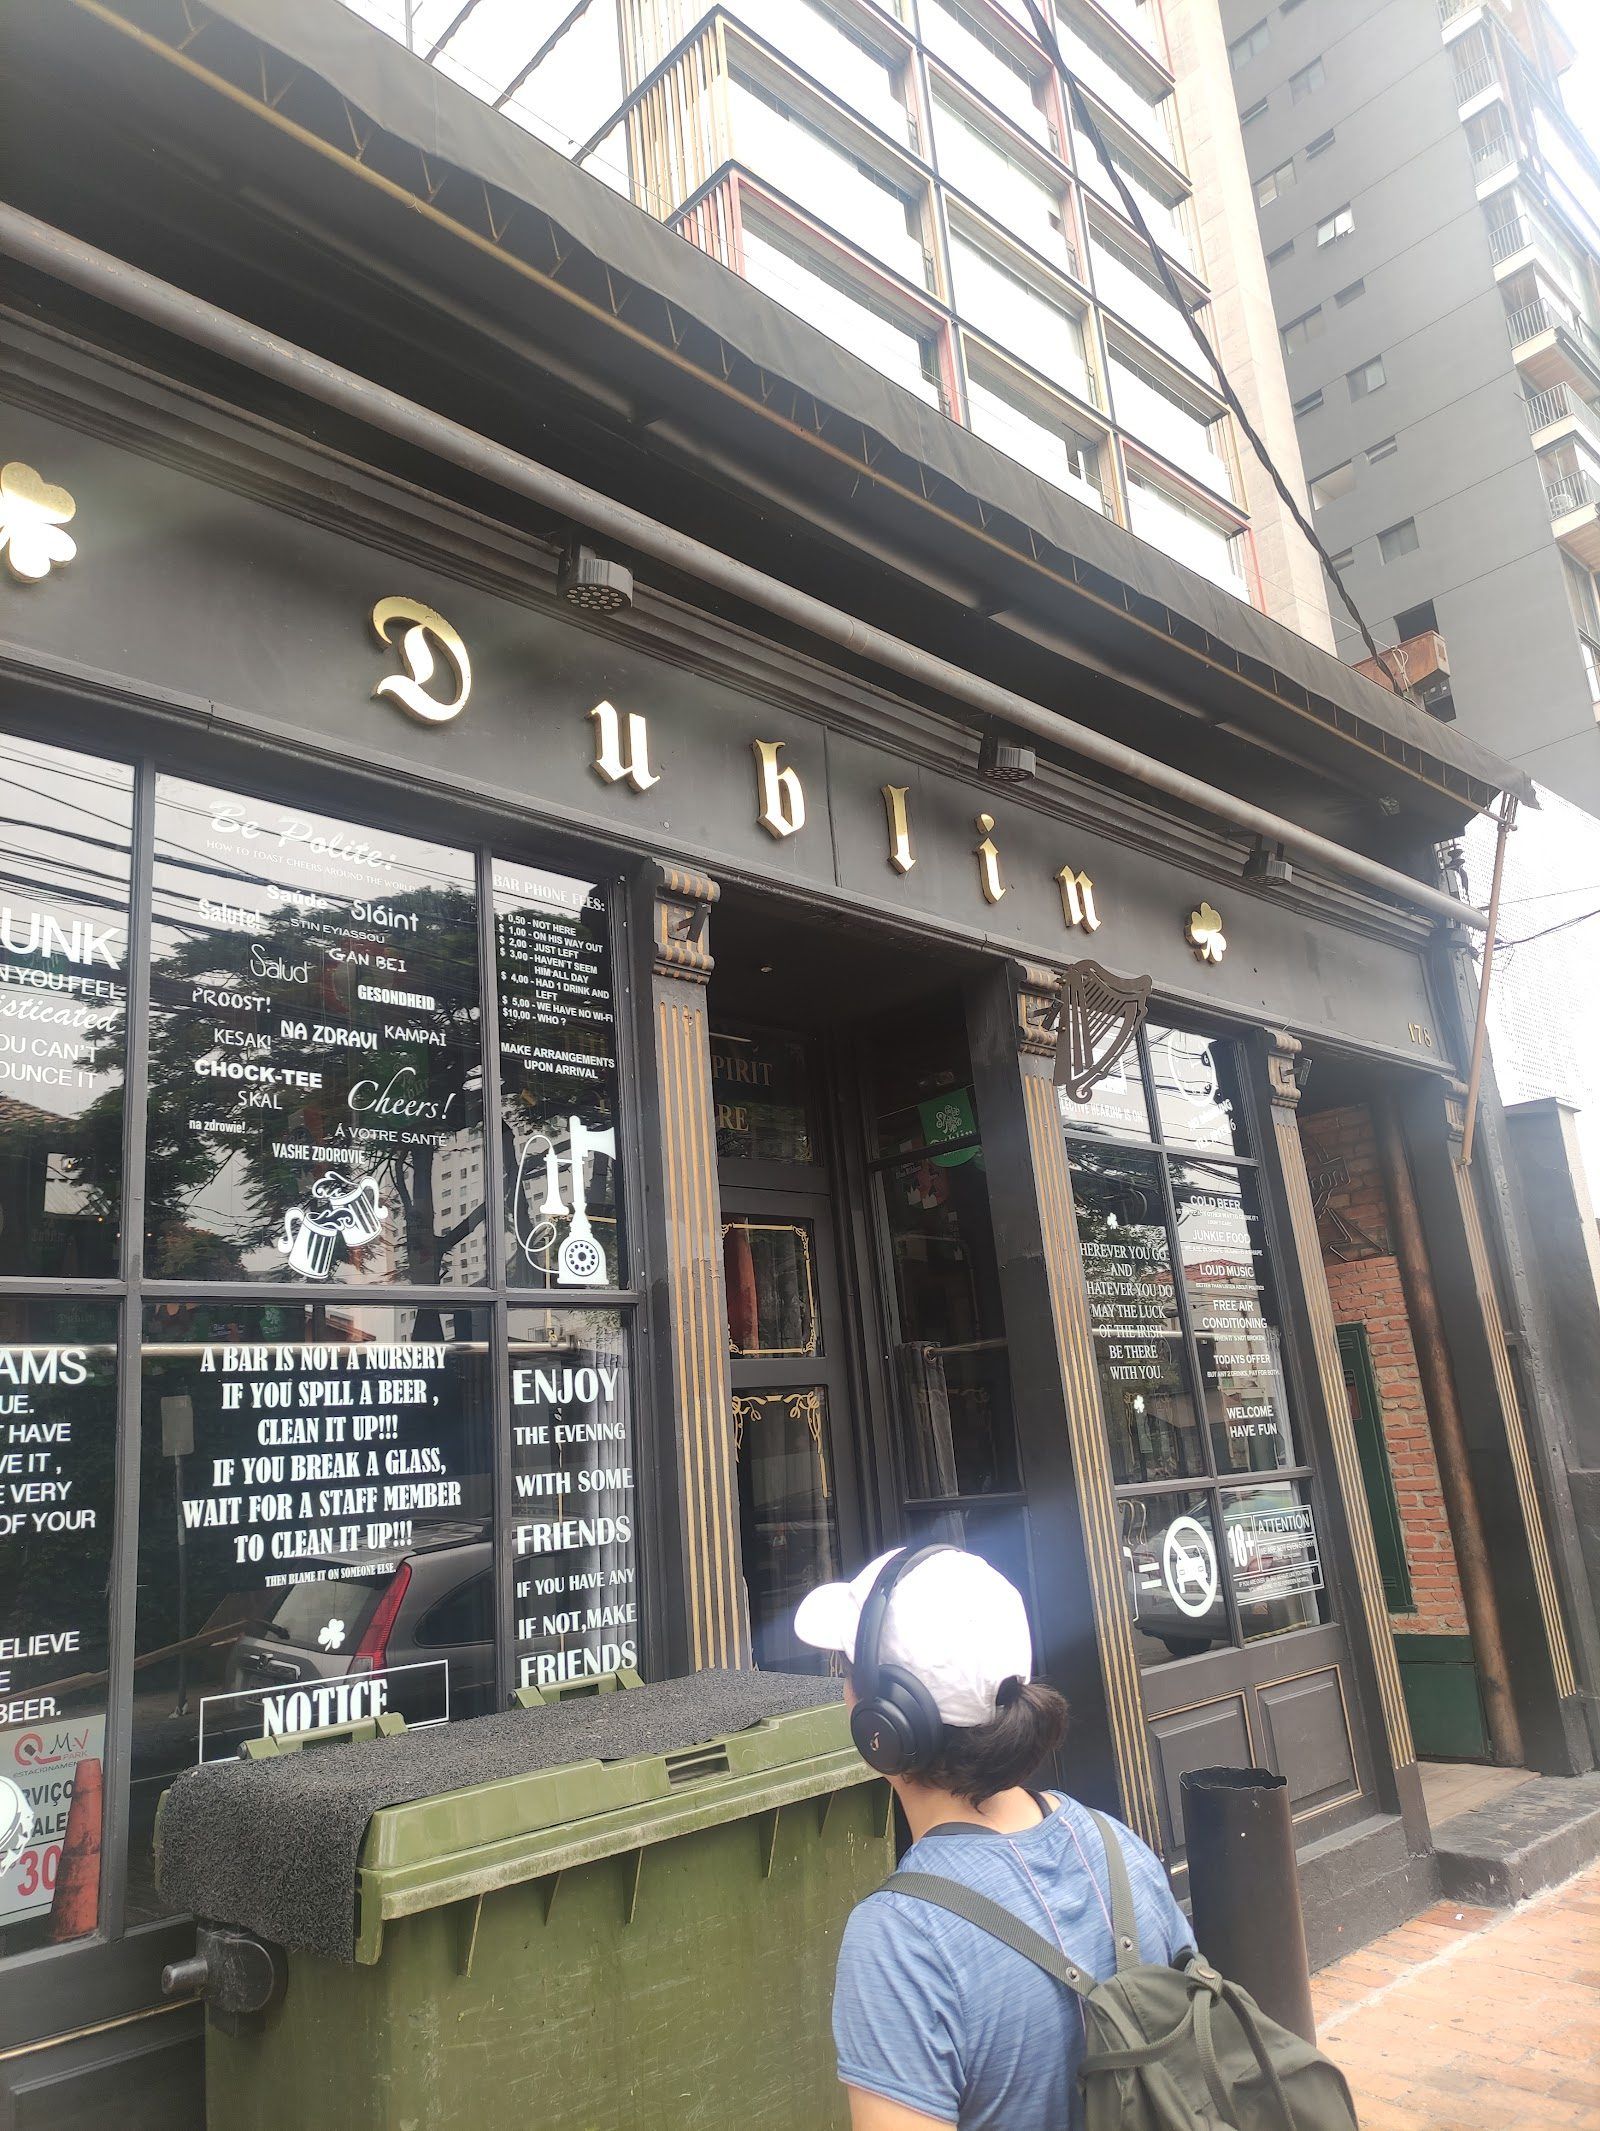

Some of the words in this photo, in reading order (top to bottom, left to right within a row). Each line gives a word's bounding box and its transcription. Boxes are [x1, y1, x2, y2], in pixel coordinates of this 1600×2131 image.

[370, 595, 1102, 936] Dublin
[209, 801, 262, 840] Be
[278, 816, 397, 870] Polite:
[206, 840, 233, 854] HOW
[253, 849, 284, 865] TOAST
[286, 858, 324, 874] CHEERS
[324, 867, 364, 882] AROUND
[365, 875, 385, 887] THE
[266, 883, 330, 911] Saúde
[493, 874, 520, 892] BAR
[524, 881, 568, 904] PHONE
[572, 891, 606, 912] FEES:
[350, 898, 420, 933] Sláint
[507, 914, 526, 928] 0,50
[532, 919, 552, 932] NOT
[552, 923, 577, 937] HERE
[0, 906, 121, 971] UNK
[290, 917, 321, 933] STIN
[322, 924, 386, 945] EYIASSOU
[508, 926, 527, 939] 1,00
[533, 931, 547, 943] ON
[548, 934, 563, 947] HIS
[564, 937, 585, 950] WAY
[585, 942, 604, 954] OUT
[327, 946, 370, 968] GAN
[375, 955, 408, 974] BEI
[508, 937, 527, 950] 2,00
[533, 943, 557, 956] JUST
[557, 947, 579, 960] LEFT
[249, 942, 310, 985] Salud
[509, 949, 529, 962] 3,00
[574, 961, 598, 975] SEEM
[534, 965, 551, 977] HIM
[552, 969, 570, 981] ALL
[571, 972, 589, 984] DAY
[14, 966, 64, 991] YOU
[68, 976, 122, 1001] FEEL
[510, 973, 530, 985] 4,00
[535, 978, 555, 991] HAD
[563, 984, 590, 996] DRINK
[592, 988, 610, 1000] AND
[535, 989, 558, 1002] LEFT
[191, 986, 272, 1014] PROOST!
[357, 984, 437, 1012] GESONDHEID
[503, 1008, 531, 1021] $10,00
[537, 1014, 557, 1026] WHO
[536, 1001, 551, 1013] WE
[552, 1004, 577, 1017] HAVE
[578, 1009, 592, 1020] NO
[593, 1011, 614, 1023] WI-FI
[214, 1028, 272, 1050] KESAK!
[280, 1019, 309, 1042] NA
[312, 1024, 379, 1050] ZDRAVI
[384, 1025, 448, 1047] KAMPAI
[1408, 1022, 1432, 1047] 178
[31, 1039, 100, 1064] CAN'T
[500, 1042, 532, 1057] MAKE
[533, 1047, 616, 1069] ARRANGEMENTS
[194, 1058, 323, 1089] CHOCK-TEE
[524, 1059, 554, 1074] UPON
[555, 1064, 600, 1080] ARRIVAL
[237, 1090, 284, 1111] SKAL
[189, 1119, 202, 1130] na
[204, 1119, 247, 1135] zdrowie!
[348, 1126, 399, 1143] VOTRE
[401, 1132, 448, 1148] SANTÉ
[272, 1142, 310, 1161] VASHE
[311, 1146, 366, 1164] ZDOROVIE
[1190, 1195, 1216, 1208] COLD
[1216, 1198, 1241, 1210] BEER
[1193, 1229, 1225, 1243] JUNKIE
[1226, 1232, 1251, 1244] FOOD
[1128, 1246, 1150, 1260] YOU
[1110, 1263, 1133, 1277] AND
[1200, 1264, 1225, 1276] LOUD
[1226, 1266, 1255, 1278] MUSIC
[1135, 1283, 1158, 1297] YOU
[1092, 1304, 1114, 1318] MAY
[1116, 1304, 1138, 1318] THE
[1138, 1304, 1166, 1319] LUCK
[1213, 1300, 1238, 1311] FREE
[1239, 1301, 1254, 1312] AIR
[1115, 1325, 1137, 1338] THE
[1137, 1324, 1164, 1338] IRISH
[1202, 1317, 1268, 1329] CONDITIONING
[222, 1346, 270, 1373] BAR
[300, 1345, 342, 1371] NOT
[366, 1344, 448, 1370] NURSERY
[1109, 1345, 1124, 1359] BE
[1126, 1344, 1158, 1359] THERE
[1213, 1354, 1245, 1365] TODAYS
[1246, 1354, 1271, 1363] OFFER
[1110, 1365, 1139, 1380] WITH
[1138, 1365, 1164, 1379] YOU.
[250, 1381, 293, 1409] YOU
[298, 1379, 354, 1408] SPILL
[377, 1379, 428, 1405] BEER
[512, 1366, 620, 1406] ENJOY
[1226, 1405, 1275, 1420] WELCOME
[8, 1422, 72, 1444] HAVE
[257, 1416, 320, 1446] CLEAN
[352, 1414, 399, 1441] UP!!!
[513, 1425, 550, 1446] THE
[555, 1421, 627, 1444] EVENING
[1229, 1424, 1256, 1438] HAVE
[1258, 1422, 1278, 1436] FUN
[241, 1455, 285, 1485] YOU
[290, 1451, 361, 1482] BREAK
[384, 1446, 447, 1476] GLASS,
[10, 1481, 73, 1503] VERY
[516, 1471, 571, 1498] WITH
[577, 1467, 635, 1494] SOME
[182, 1496, 243, 1529] WAIT
[247, 1493, 293, 1523] FOR
[319, 1485, 379, 1517] STAFF
[383, 1480, 462, 1512] MEMBER
[32, 1509, 97, 1532] YOUR
[1258, 1514, 1311, 1535] ATTENTION
[271, 1527, 334, 1560] CLEAN
[366, 1519, 413, 1549] UP!!!
[516, 1514, 632, 1555] FRIENDS
[1227, 1524, 1255, 1568] 18+
[265, 1574, 288, 1587] THEN
[288, 1571, 316, 1585] BLAME
[327, 1568, 340, 1580] ON
[340, 1564, 376, 1579] SOMEONE
[376, 1562, 397, 1575] ELSE.
[535, 1577, 565, 1596] YOU
[569, 1571, 605, 1592] HAVE
[608, 1567, 635, 1588] ANY
[520, 1640, 638, 1688] FRIENDS
[262, 1678, 388, 1739] NOTICE
[63, 1750, 88, 1760] PARK
